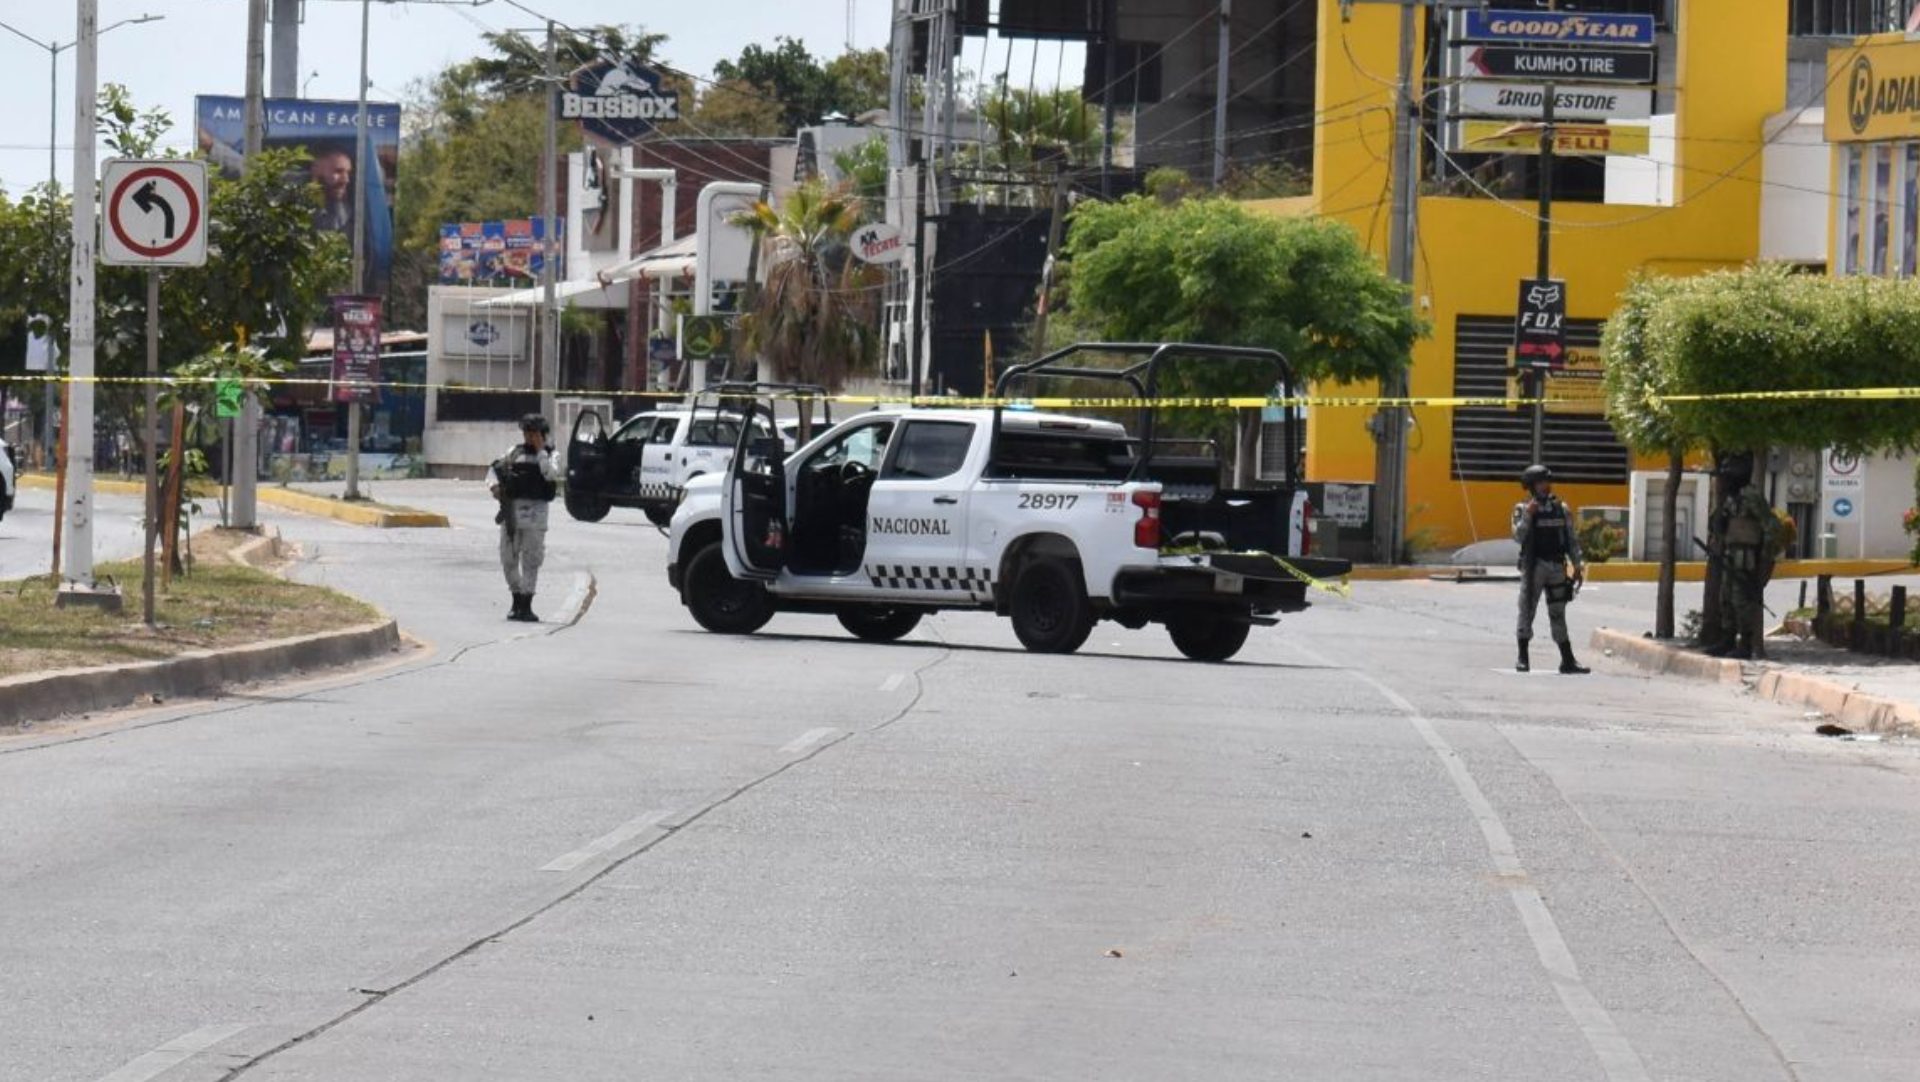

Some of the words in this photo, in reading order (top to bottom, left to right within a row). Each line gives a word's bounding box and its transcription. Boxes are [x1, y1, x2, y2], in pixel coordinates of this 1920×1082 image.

[1490, 17, 1638, 38] GOODYEAR
[1514, 55, 1576, 72] KUMHO
[1581, 57, 1615, 73] TIRE
[1497, 89, 1618, 110] BRIDESTONE
[212, 106, 315, 124] AMICAN
[1521, 311, 1563, 329] FOX
[1017, 493, 1079, 510] 28917
[872, 516, 951, 535] NACIONAL
